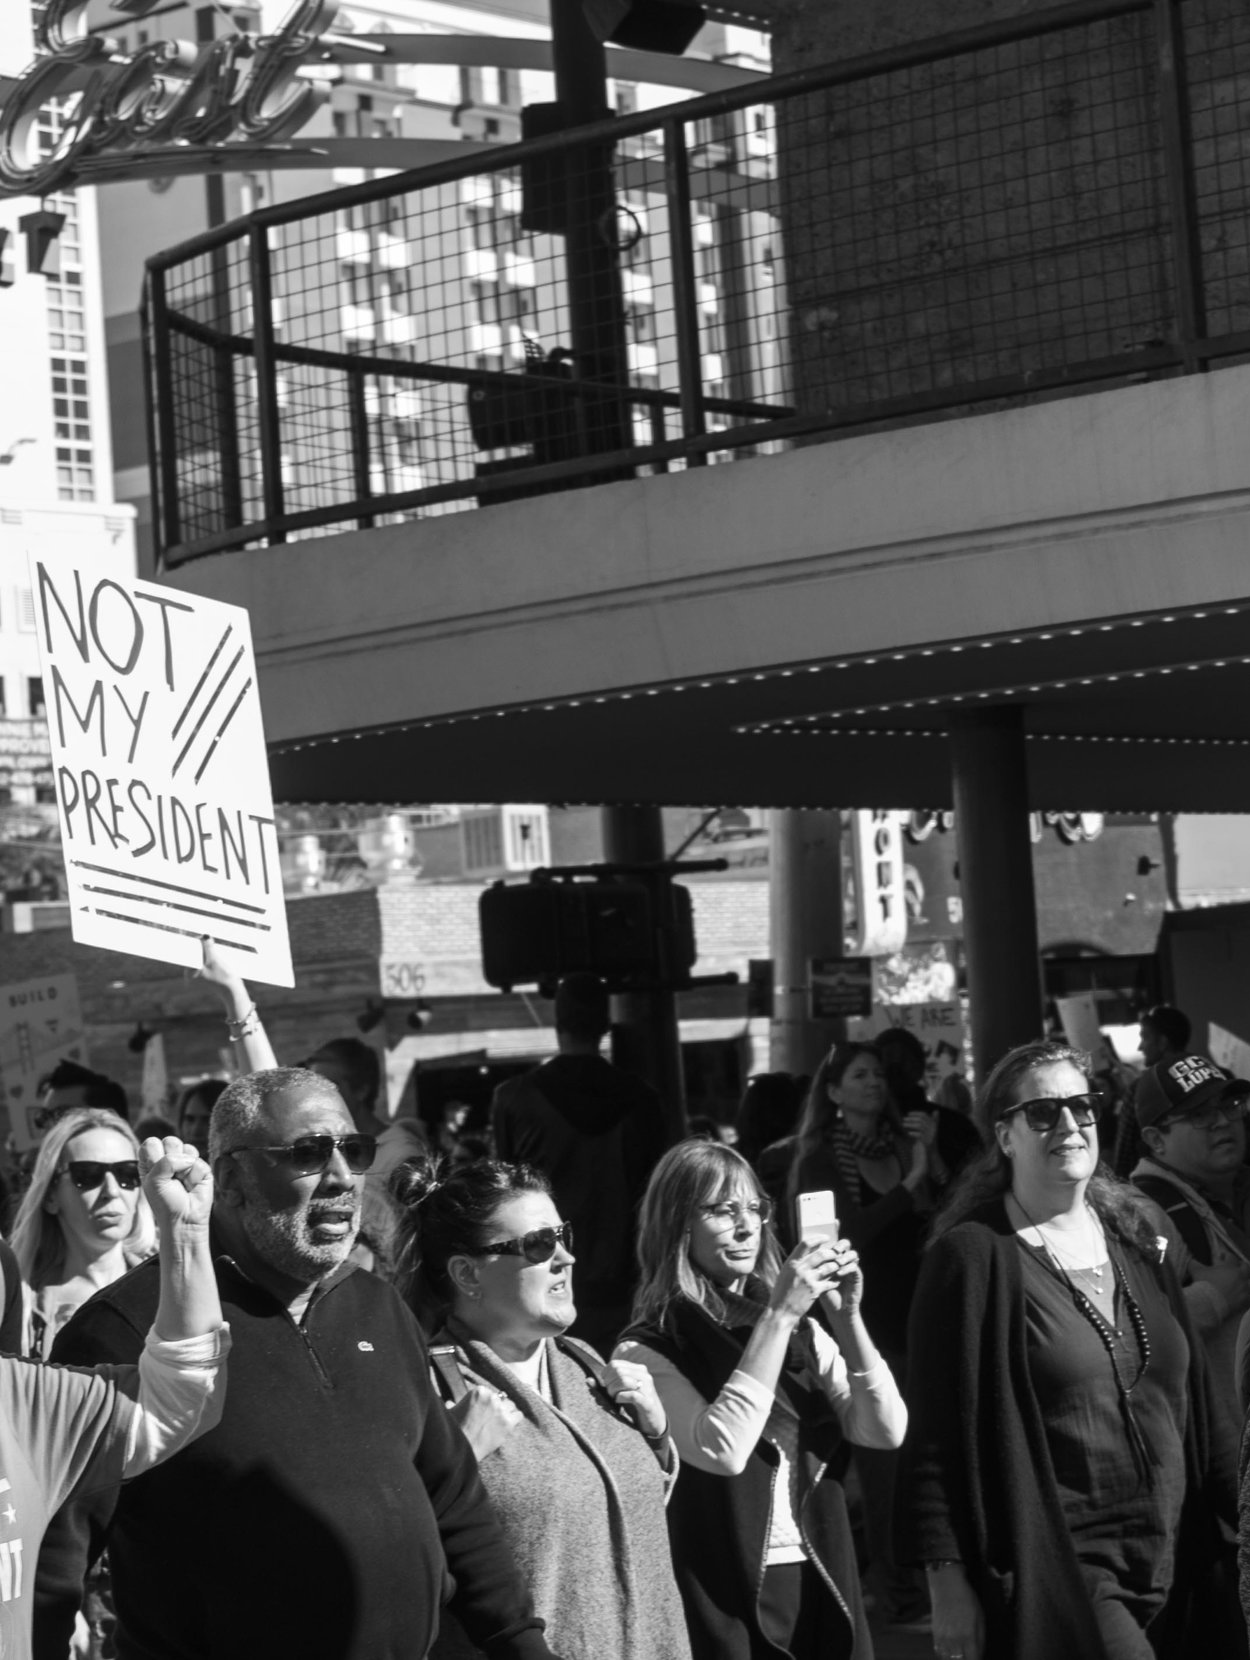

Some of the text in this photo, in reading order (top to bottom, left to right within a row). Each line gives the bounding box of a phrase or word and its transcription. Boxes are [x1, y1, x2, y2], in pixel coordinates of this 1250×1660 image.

[36, 561, 195, 692] NOT
[50, 663, 149, 764] MY
[58, 765, 276, 895] PRESIDENT
